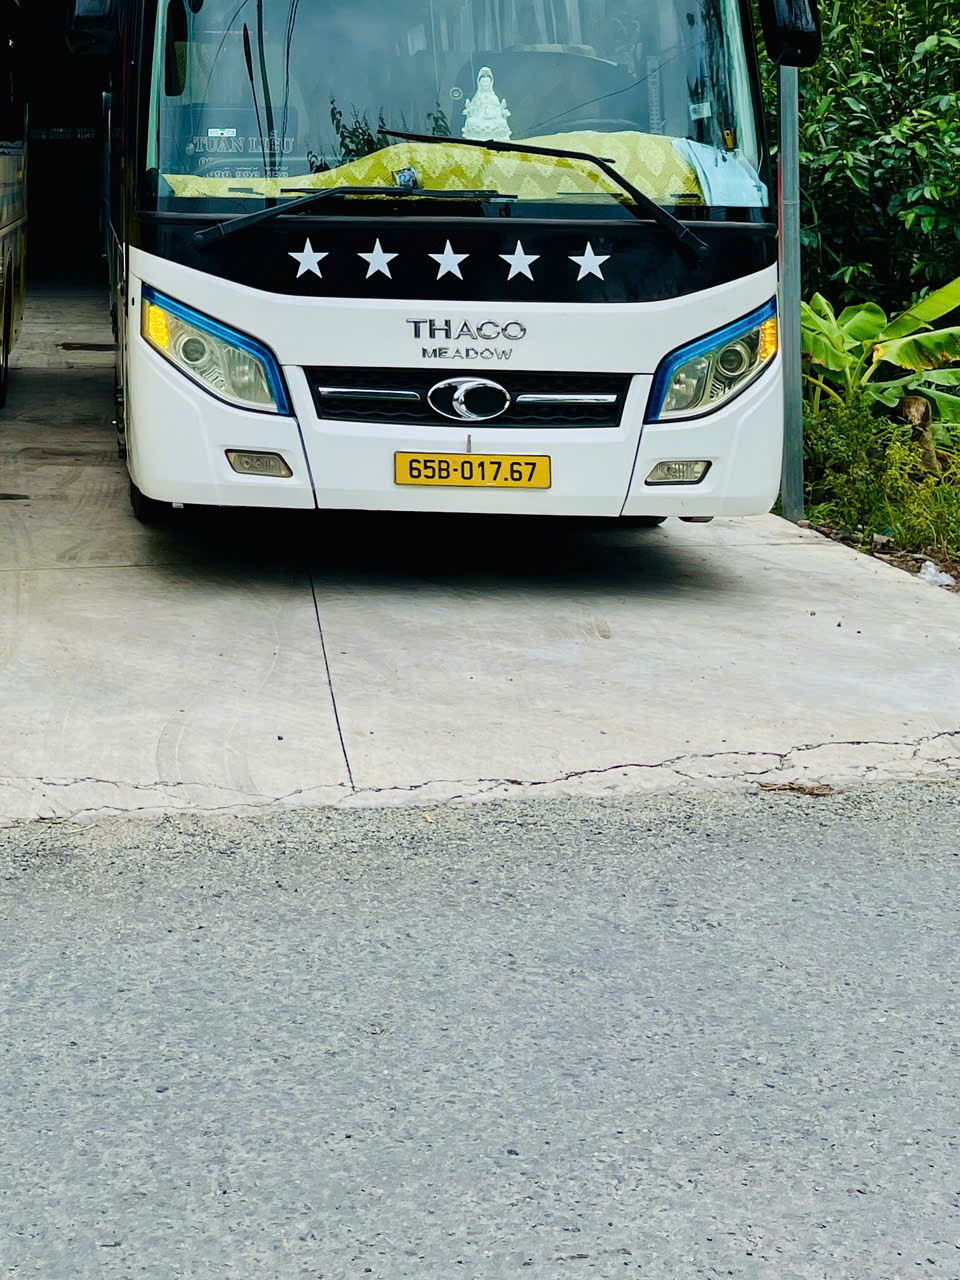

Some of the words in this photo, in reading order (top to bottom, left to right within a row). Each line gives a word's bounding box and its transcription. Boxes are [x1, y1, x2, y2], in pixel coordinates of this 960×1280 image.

[406, 319, 527, 340] THACO
[422, 347, 513, 360] MEADOW
[409, 459, 537, 482] 65B-017.67
